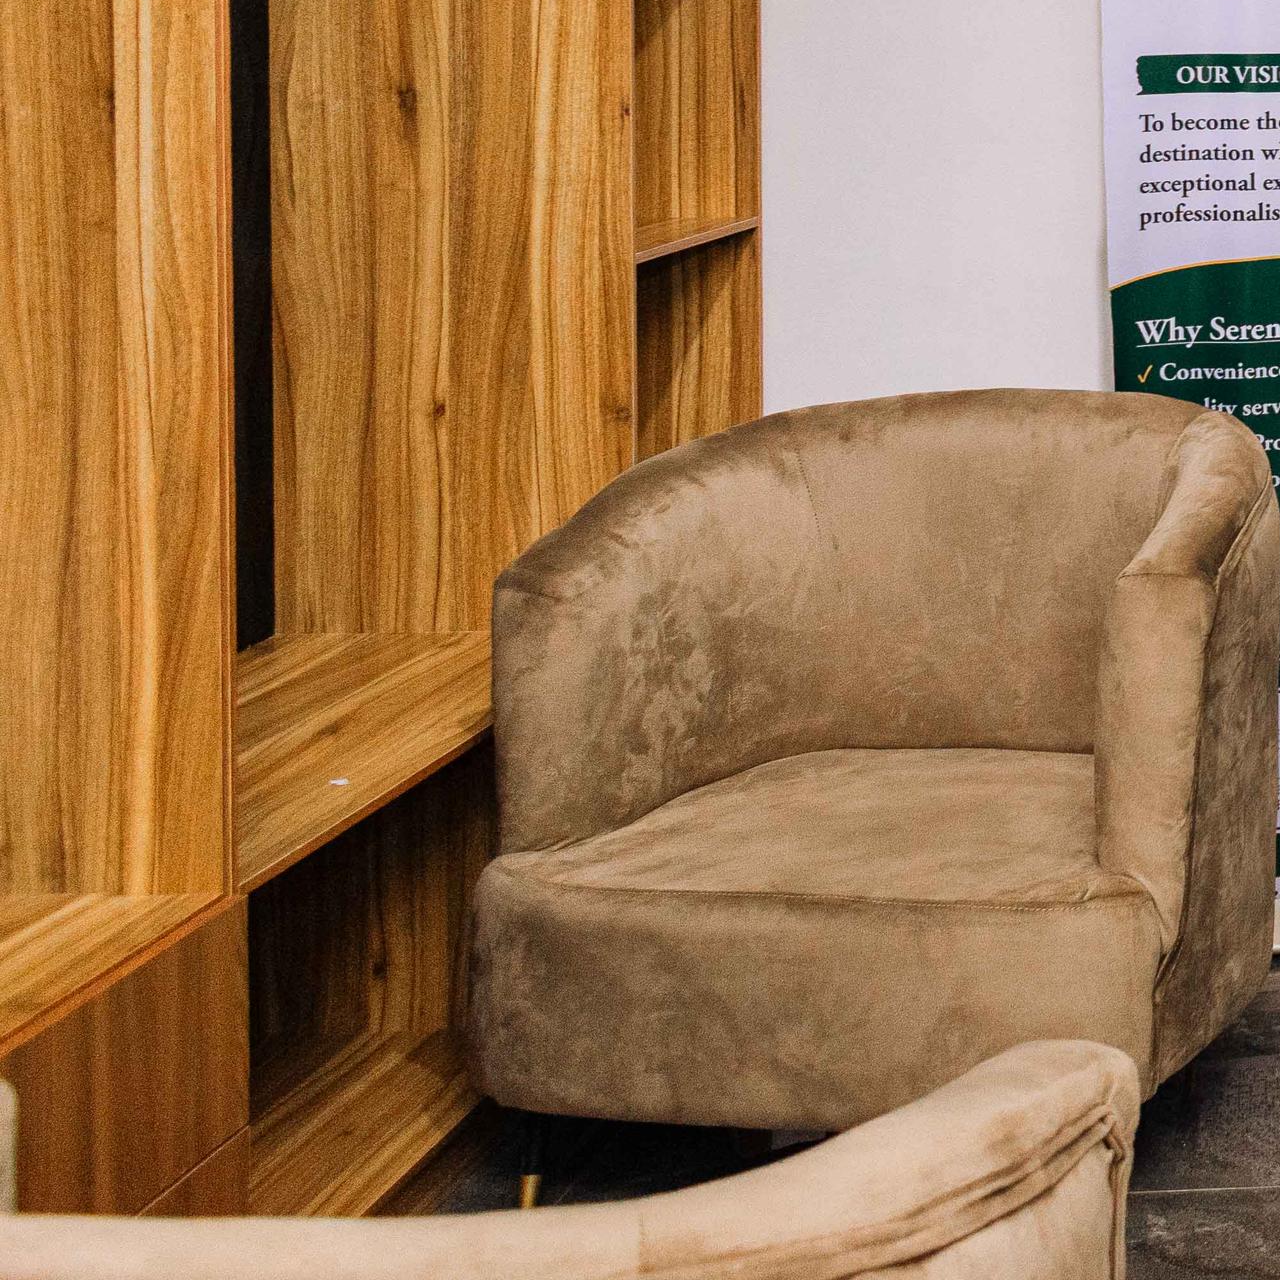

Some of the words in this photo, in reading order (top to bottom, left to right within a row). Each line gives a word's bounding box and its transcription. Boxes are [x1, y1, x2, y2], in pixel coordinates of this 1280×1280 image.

[1176, 65, 1230, 84] OUR
[1139, 113, 1164, 133] To
[1171, 112, 1250, 132] become
[1139, 143, 1255, 164] destination
[1139, 172, 1257, 198] exceptional
[1135, 316, 1202, 348] Why
